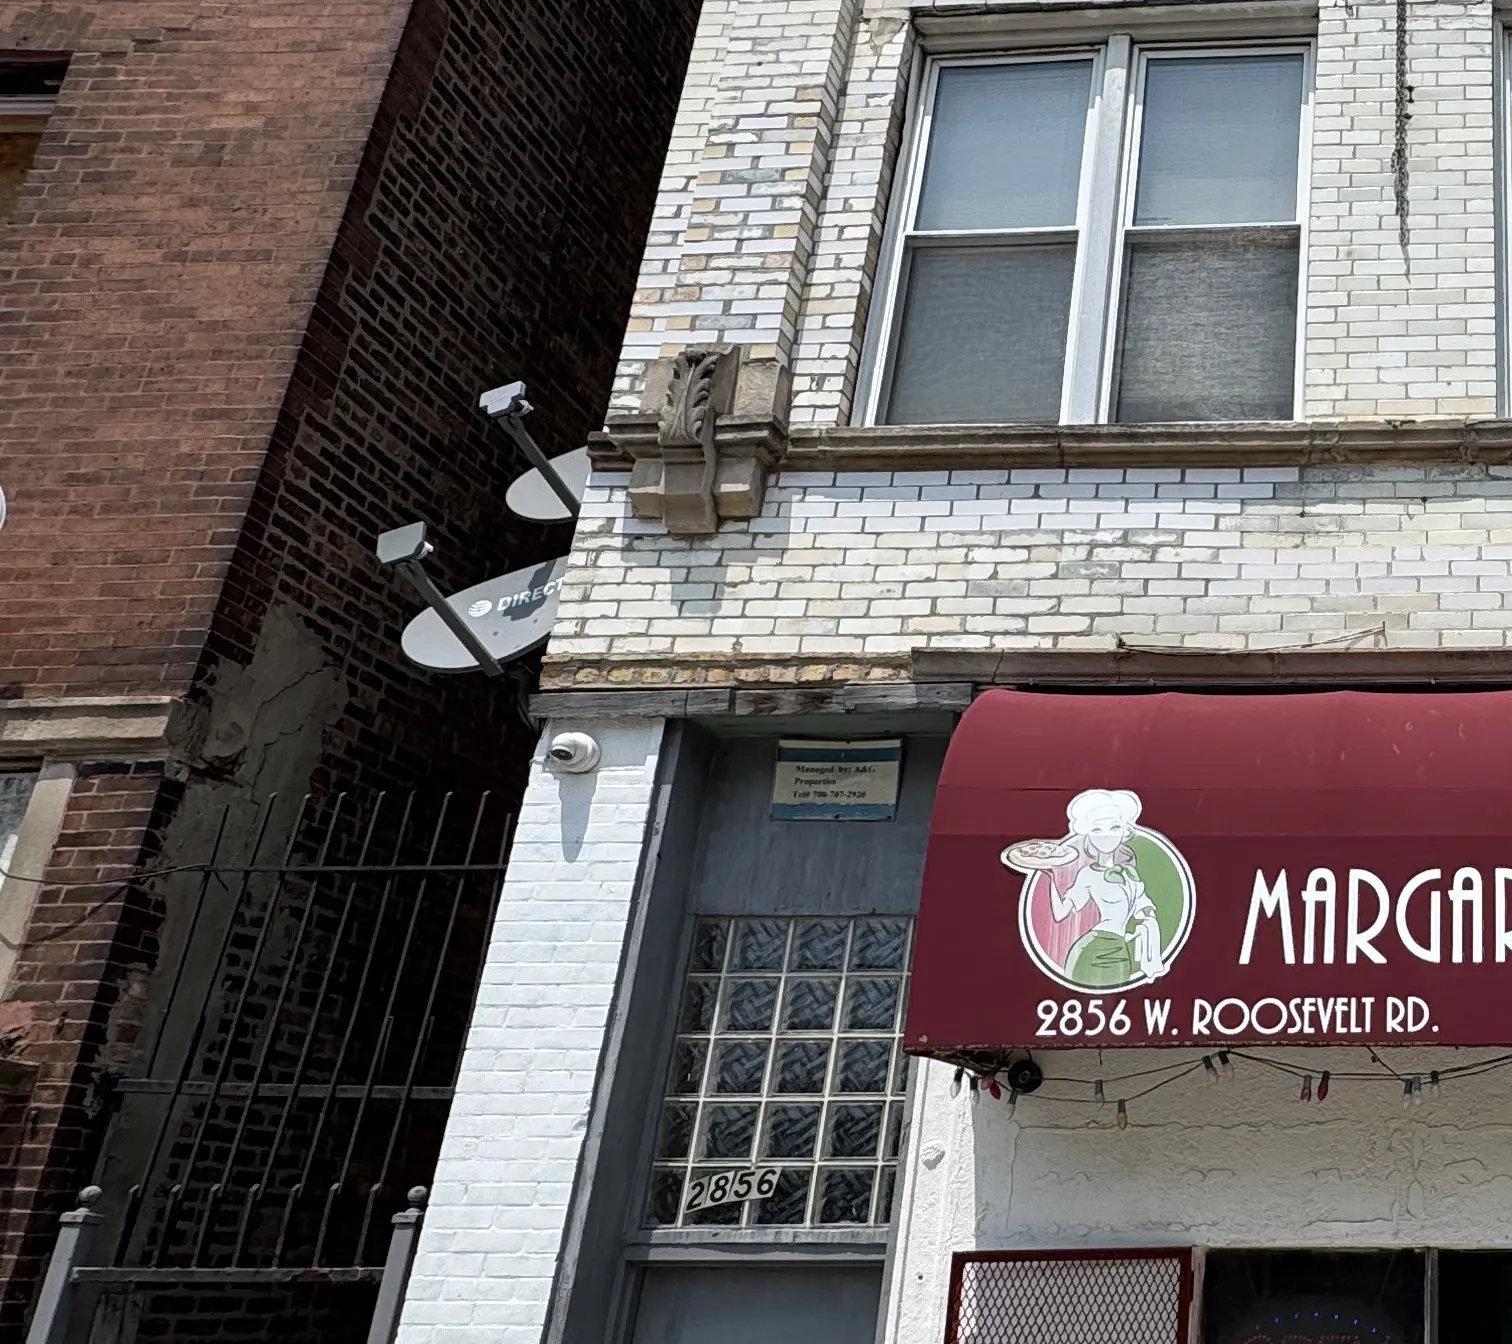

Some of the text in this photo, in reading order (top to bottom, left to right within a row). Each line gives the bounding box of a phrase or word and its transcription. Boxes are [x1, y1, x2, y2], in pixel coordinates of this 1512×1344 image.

[1034, 995, 1441, 1037] 2856 W. ROOSEVELT RD.
[685, 1168, 778, 1211] 2856
